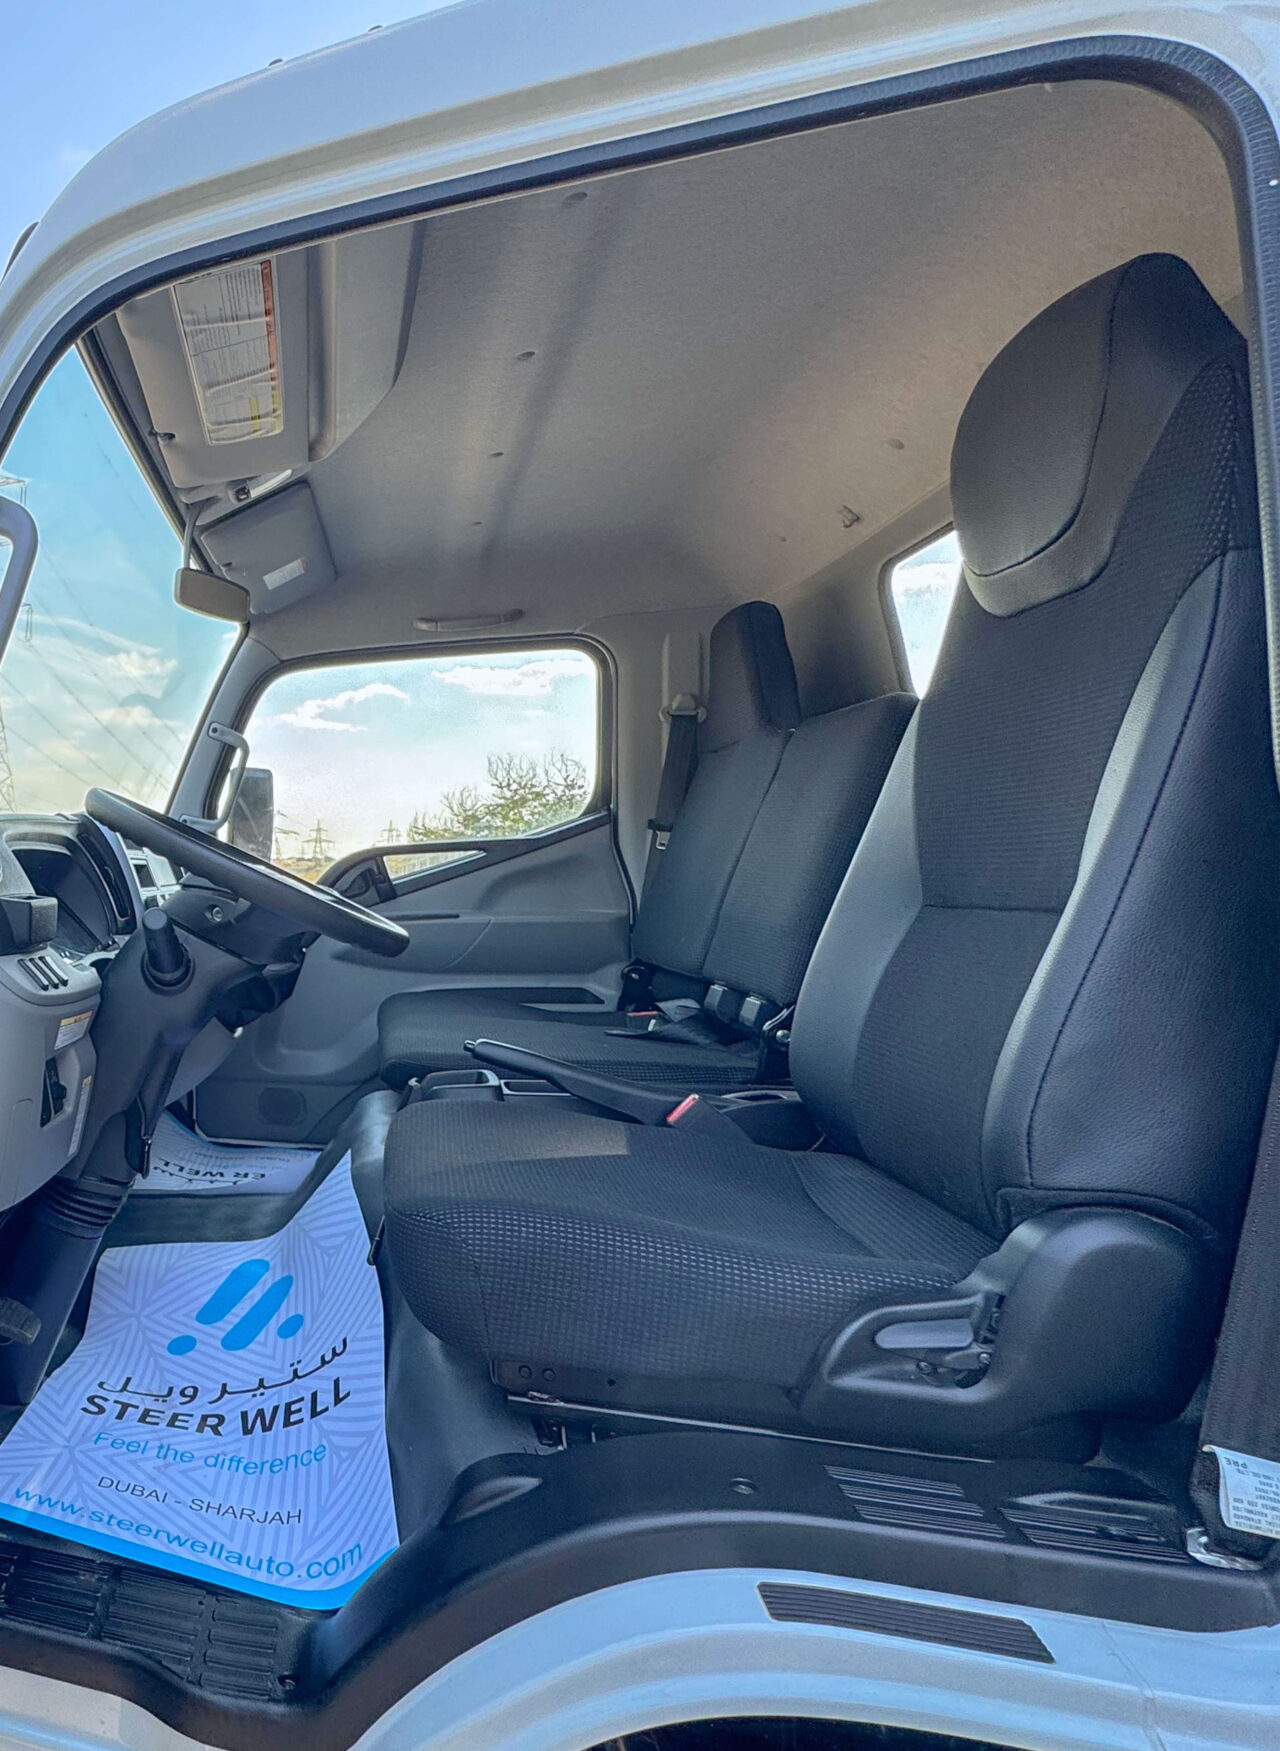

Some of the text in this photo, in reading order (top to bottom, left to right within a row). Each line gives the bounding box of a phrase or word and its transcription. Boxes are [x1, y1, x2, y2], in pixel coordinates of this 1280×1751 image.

[159, 1157, 225, 1178] WELL
[97, 1336, 348, 1406] ستير ويل
[80, 1376, 351, 1437] STEER WELL
[93, 1431, 328, 1477] Feel the difference
[98, 1475, 168, 1503] DUBAI
[188, 1497, 303, 1526] SHARJAH
[14, 1486, 364, 1581] www.steerwellauto.com
